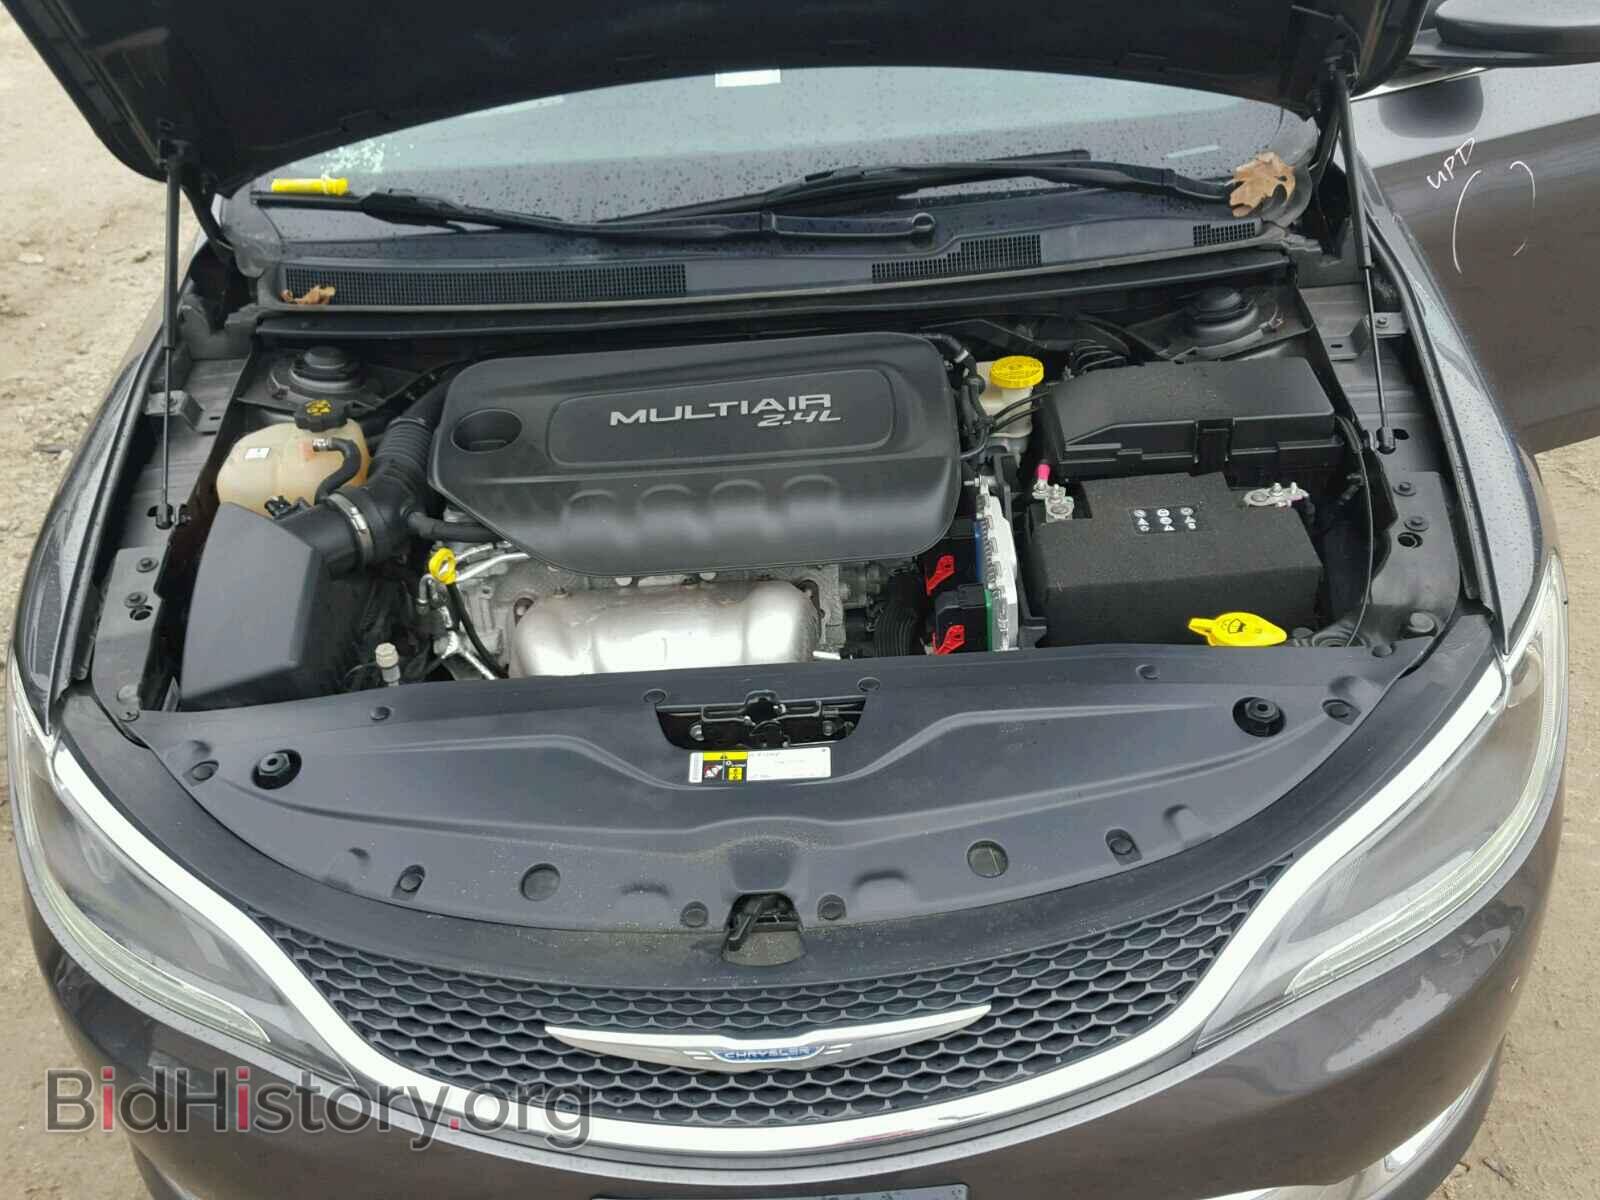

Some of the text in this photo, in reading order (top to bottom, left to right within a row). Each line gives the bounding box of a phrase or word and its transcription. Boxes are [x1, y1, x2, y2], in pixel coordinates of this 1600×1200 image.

[609, 393, 832, 426] MULTIAIR
[757, 409, 841, 427] 2.4L
[724, 1046, 811, 1060] CHRYSLER
